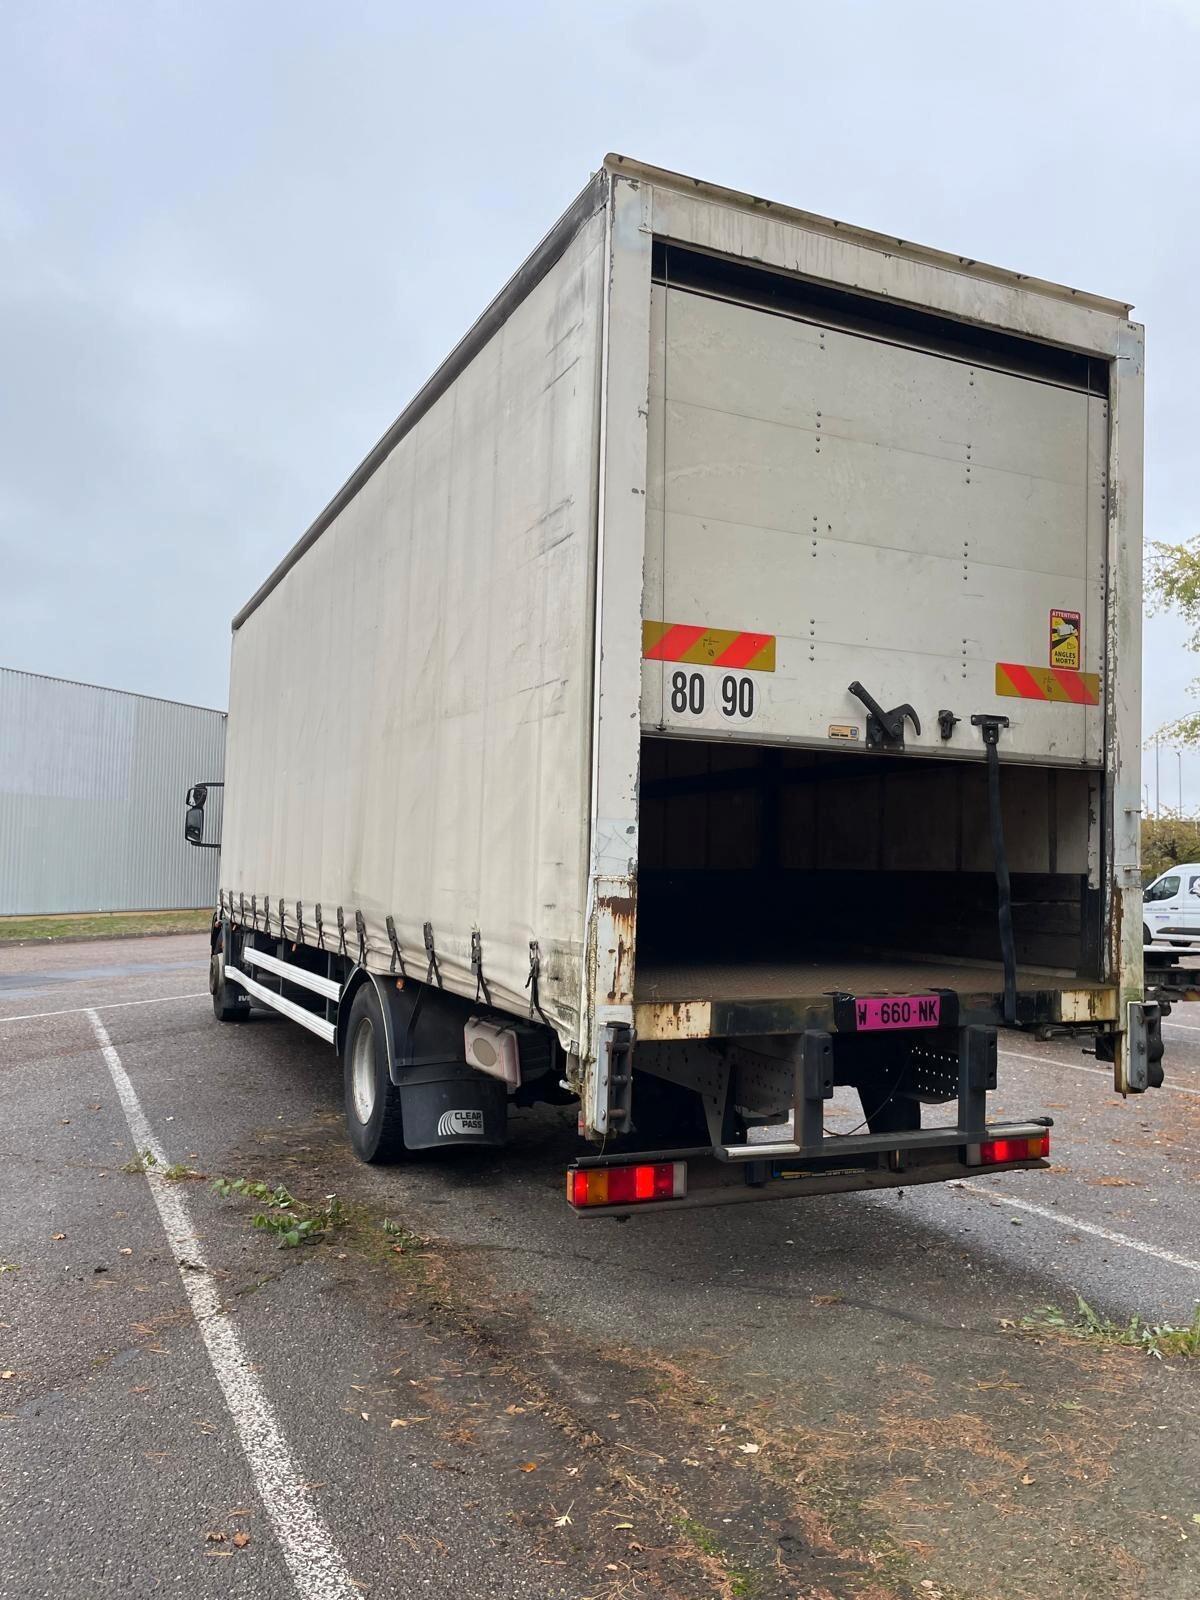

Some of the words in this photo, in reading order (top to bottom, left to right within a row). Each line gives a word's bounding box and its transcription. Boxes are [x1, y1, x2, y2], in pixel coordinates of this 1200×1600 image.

[1052, 611, 1079, 619] ATTENTION
[1054, 650, 1076, 659] ANGLES
[1055, 657, 1075, 665] MORTS
[671, 671, 705, 714] 80
[722, 675, 754, 718] 90
[454, 1112, 482, 1120] CLEAR
[462, 1120, 483, 1128] PASS
